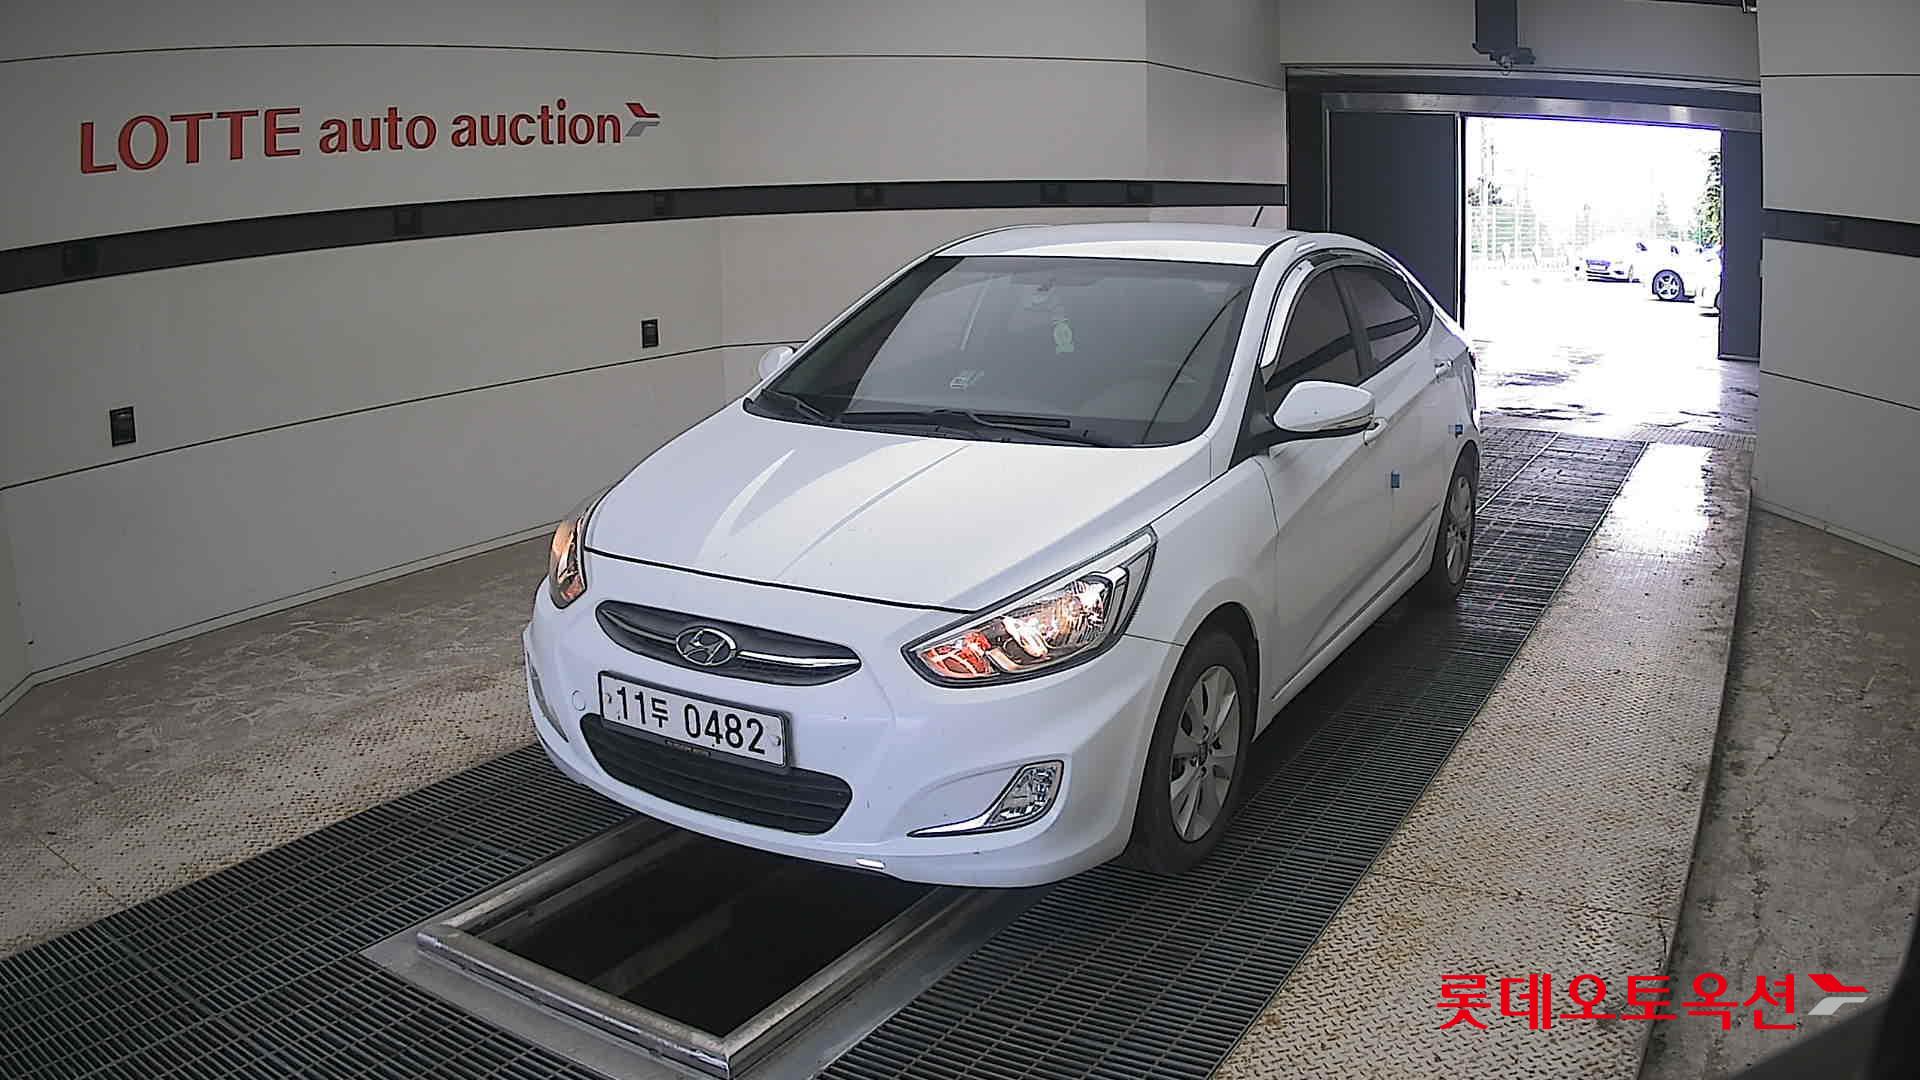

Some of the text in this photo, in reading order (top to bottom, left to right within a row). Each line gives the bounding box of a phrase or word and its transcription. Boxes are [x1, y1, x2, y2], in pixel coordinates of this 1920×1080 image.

[80, 99, 621, 174] LOTTE auto auction
[616, 686, 766, 755] 11두 0482
